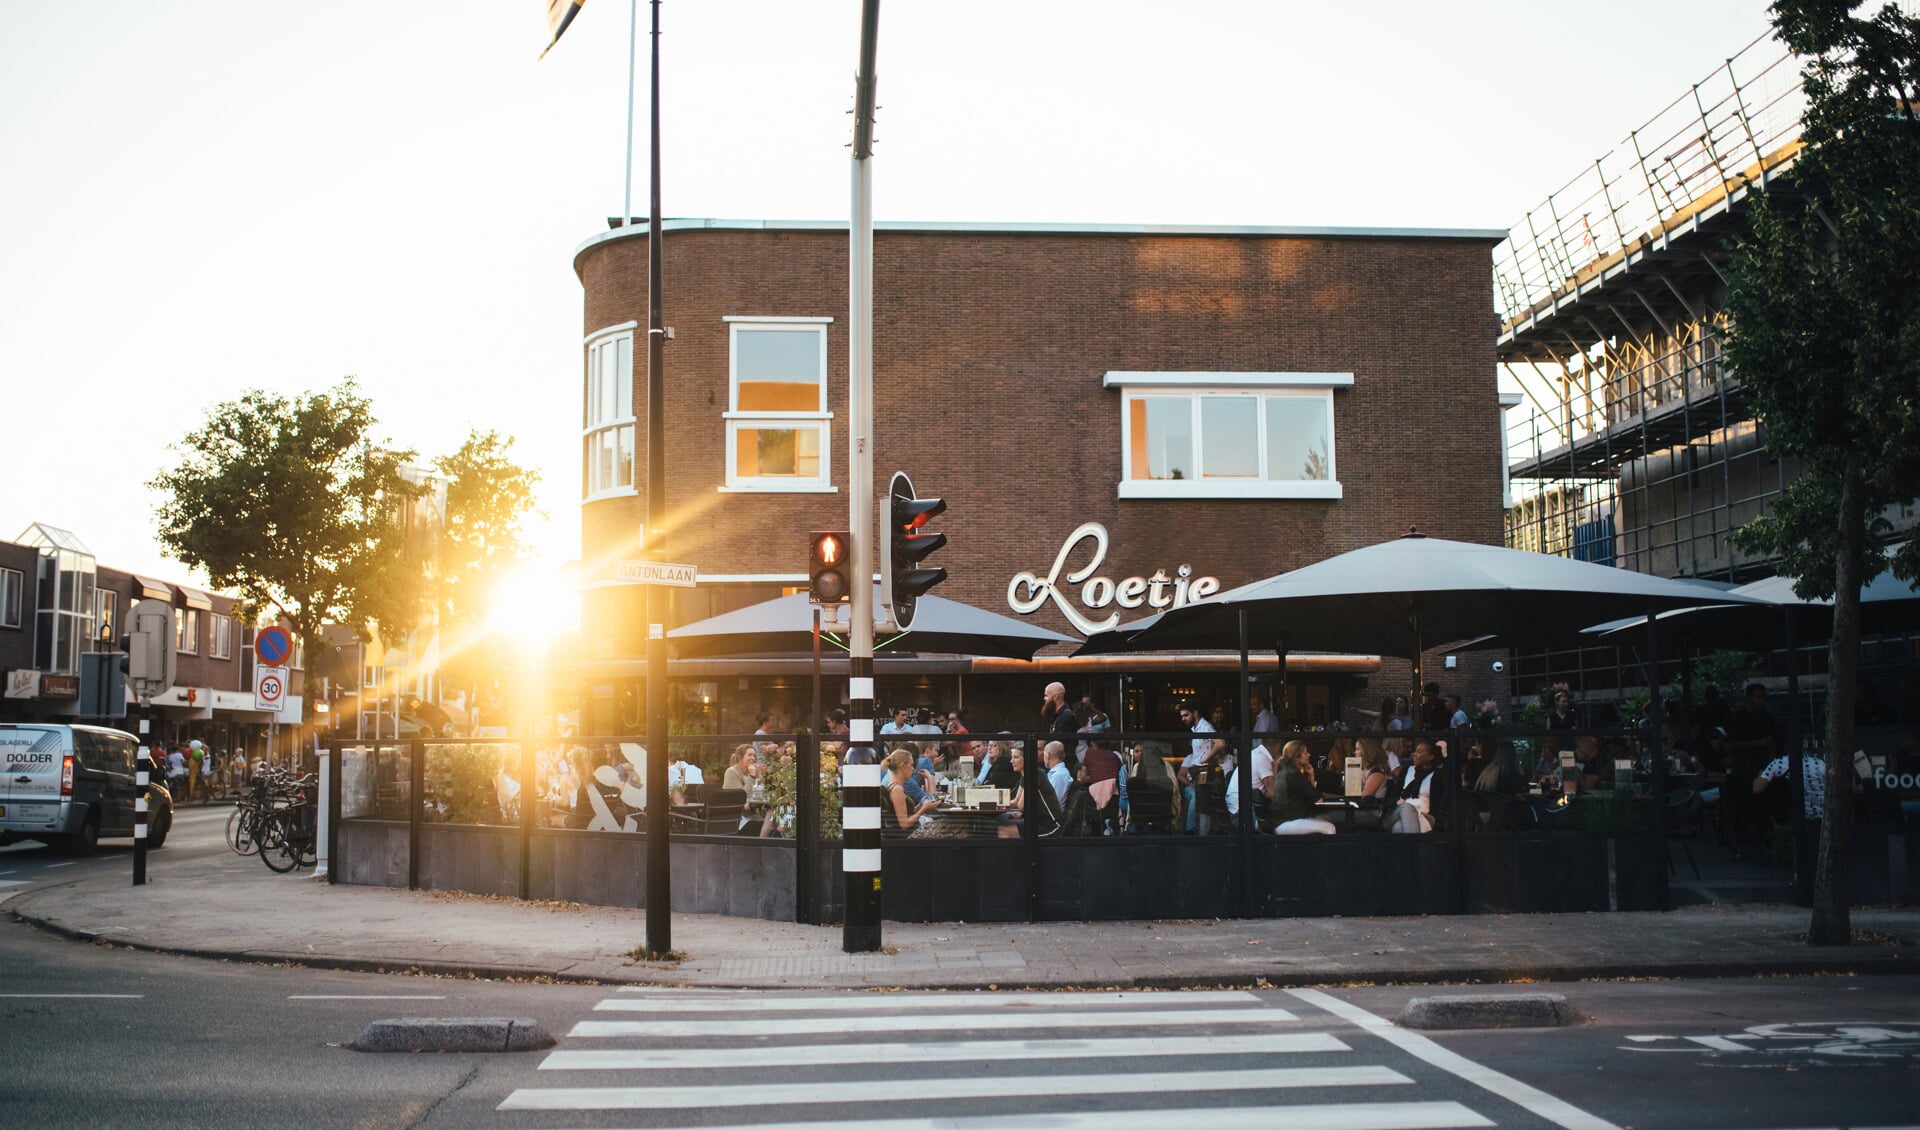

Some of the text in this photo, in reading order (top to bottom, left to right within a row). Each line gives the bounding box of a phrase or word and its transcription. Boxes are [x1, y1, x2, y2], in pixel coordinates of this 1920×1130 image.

[1007, 521, 1221, 637] Loetje
[263, 682, 279, 695] 30
[7, 753, 53, 763] DOLDER
